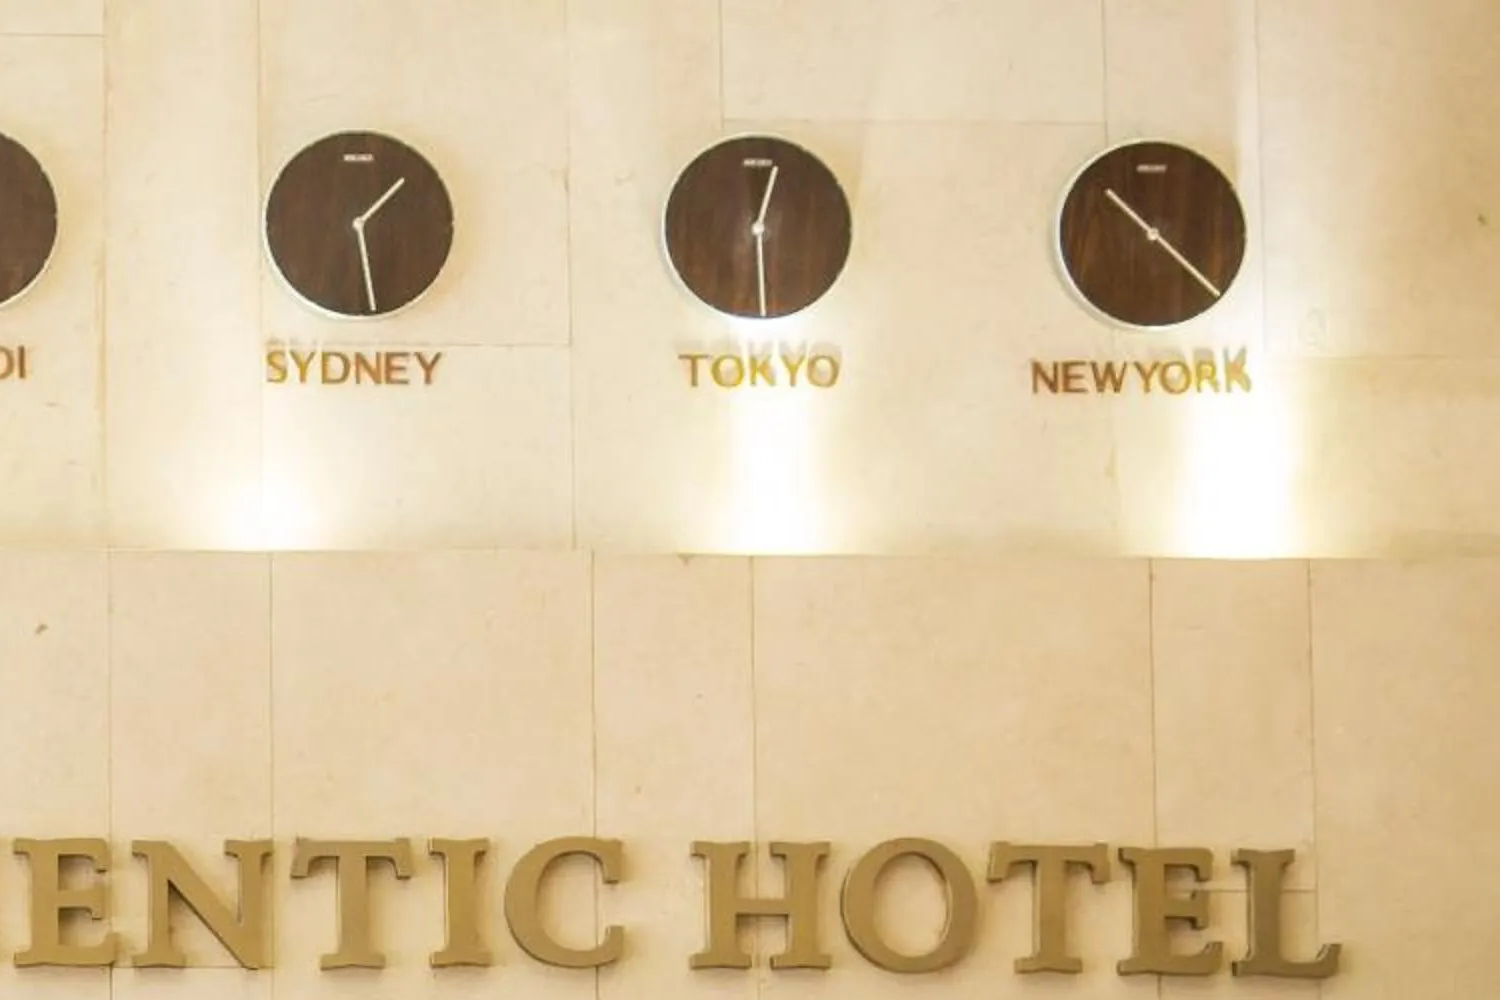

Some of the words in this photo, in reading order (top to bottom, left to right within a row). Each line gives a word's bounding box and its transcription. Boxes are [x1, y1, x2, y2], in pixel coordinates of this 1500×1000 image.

[266, 350, 443, 386] SYDNEY
[678, 352, 843, 389] TOKYO
[689, 836, 1342, 978] HOTEL
